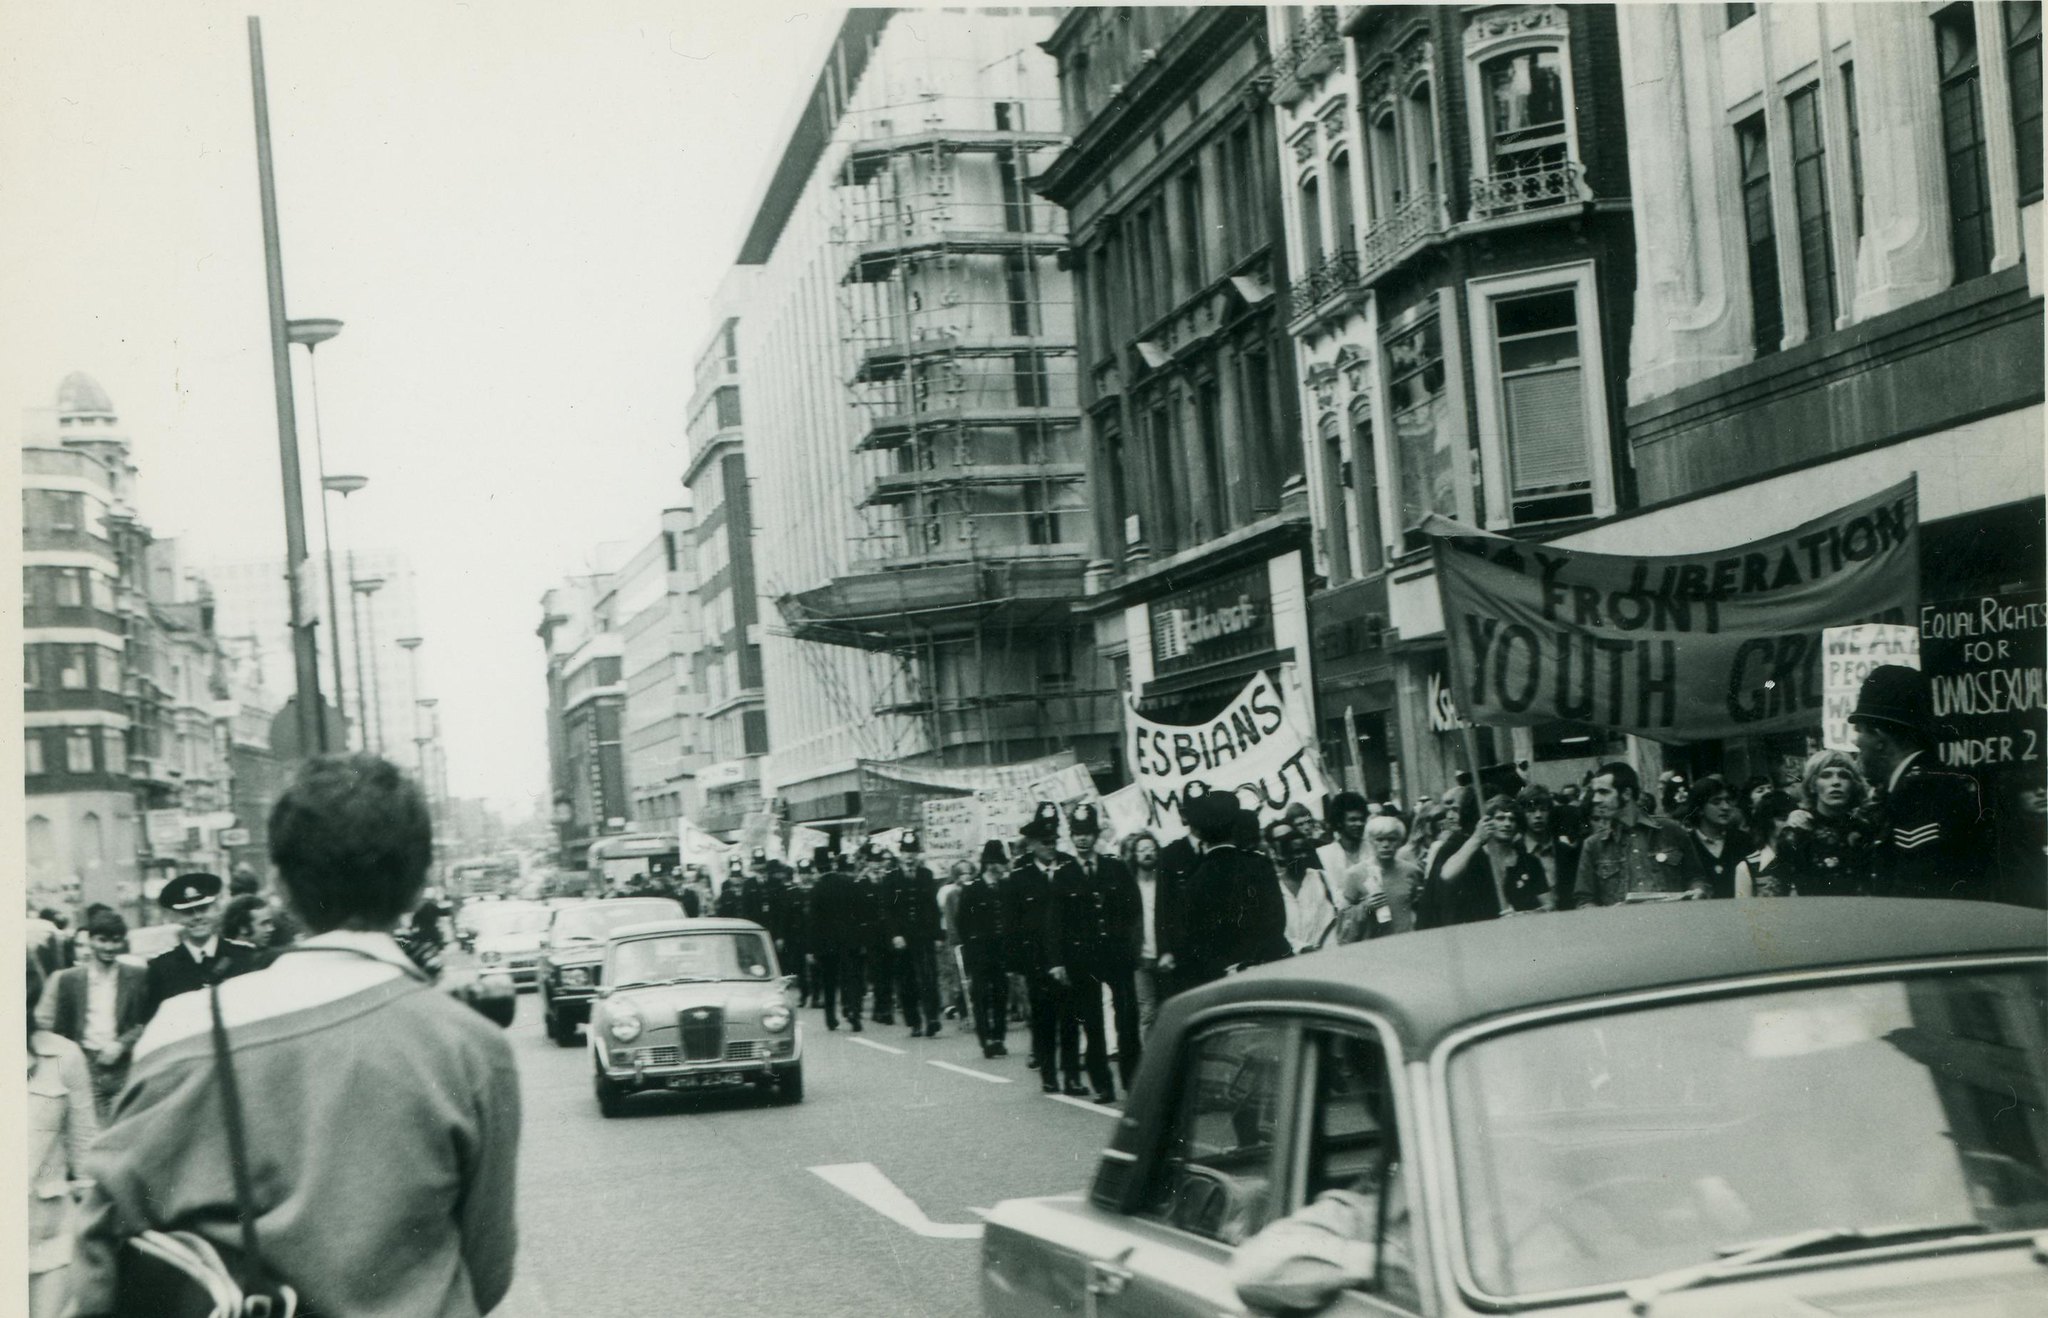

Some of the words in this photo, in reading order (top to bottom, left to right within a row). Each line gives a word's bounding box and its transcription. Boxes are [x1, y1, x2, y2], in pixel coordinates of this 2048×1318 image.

[1629, 499, 1908, 600] LIBERATION
[1543, 580, 1729, 634] FRONT
[1921, 605, 1979, 639] EQUAL
[1980, 597, 2047, 634] RIGHTS
[1828, 626, 1863, 656] WE
[1963, 640, 2010, 662] FOR
[1464, 613, 1676, 728] YOUTH
[1931, 667, 2047, 717] OMOSEXUAL
[1136, 684, 1283, 777] ESBIANS
[1938, 736, 2014, 768] UNDER
